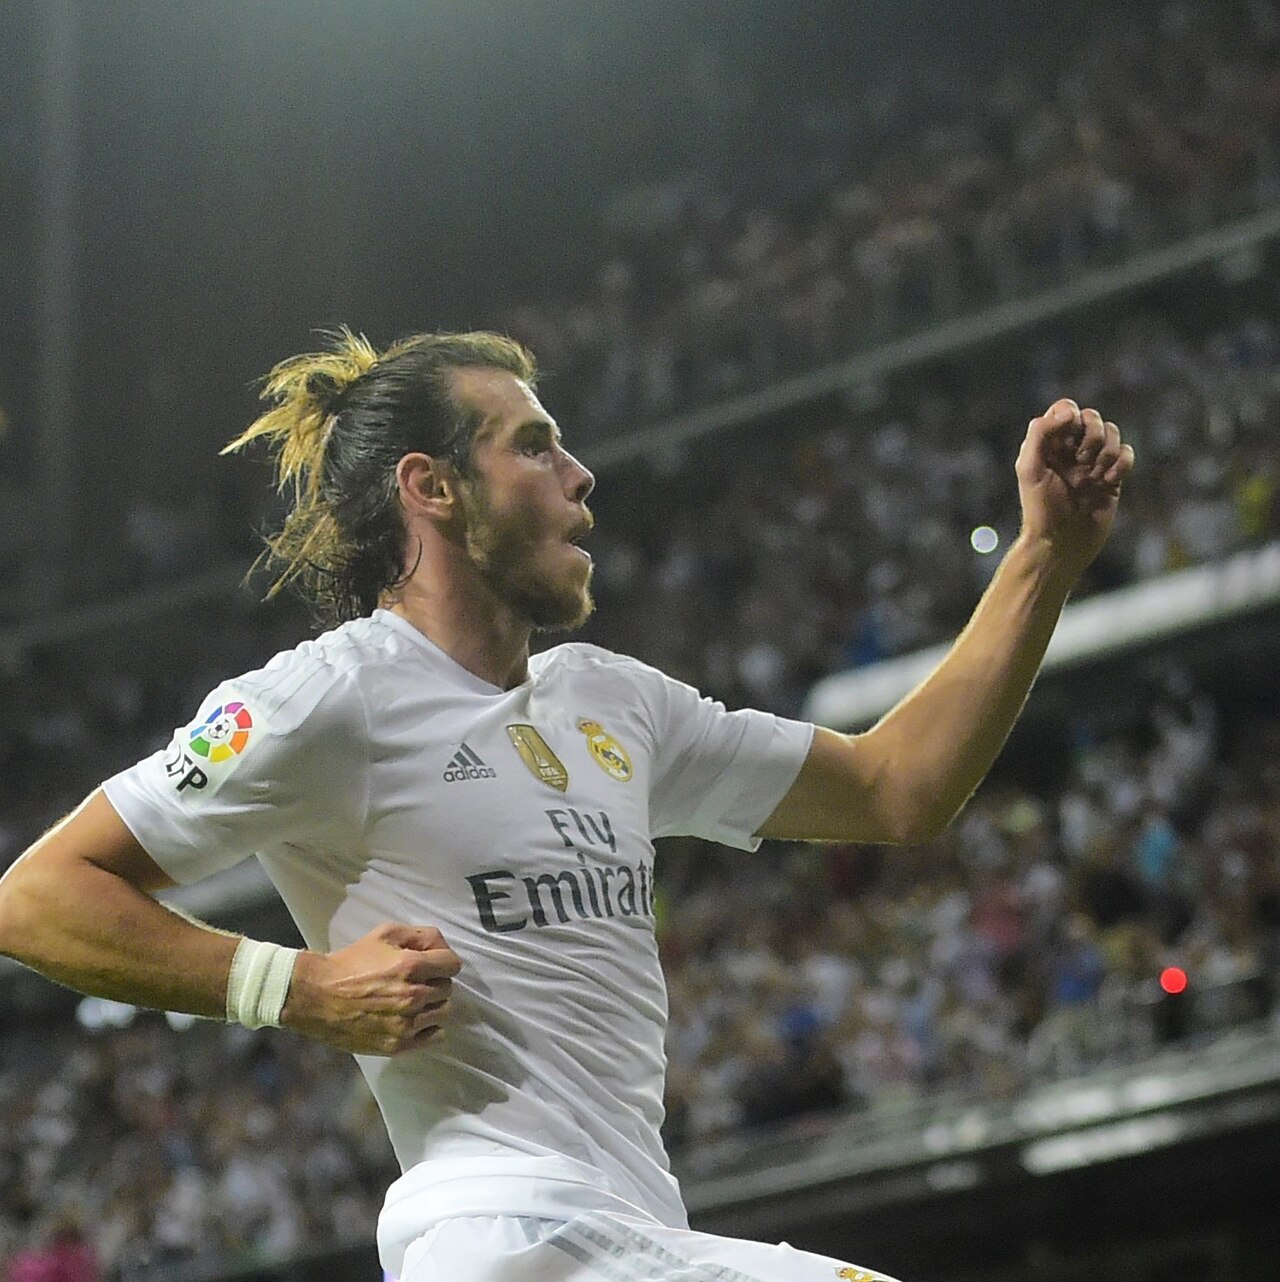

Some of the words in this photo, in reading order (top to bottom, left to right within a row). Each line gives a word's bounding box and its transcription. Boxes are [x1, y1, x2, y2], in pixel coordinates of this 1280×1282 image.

[165, 744, 208, 792] LFP
[443, 765, 497, 783] adidas
[545, 808, 617, 853] Fly
[465, 852, 655, 933] Emirat
